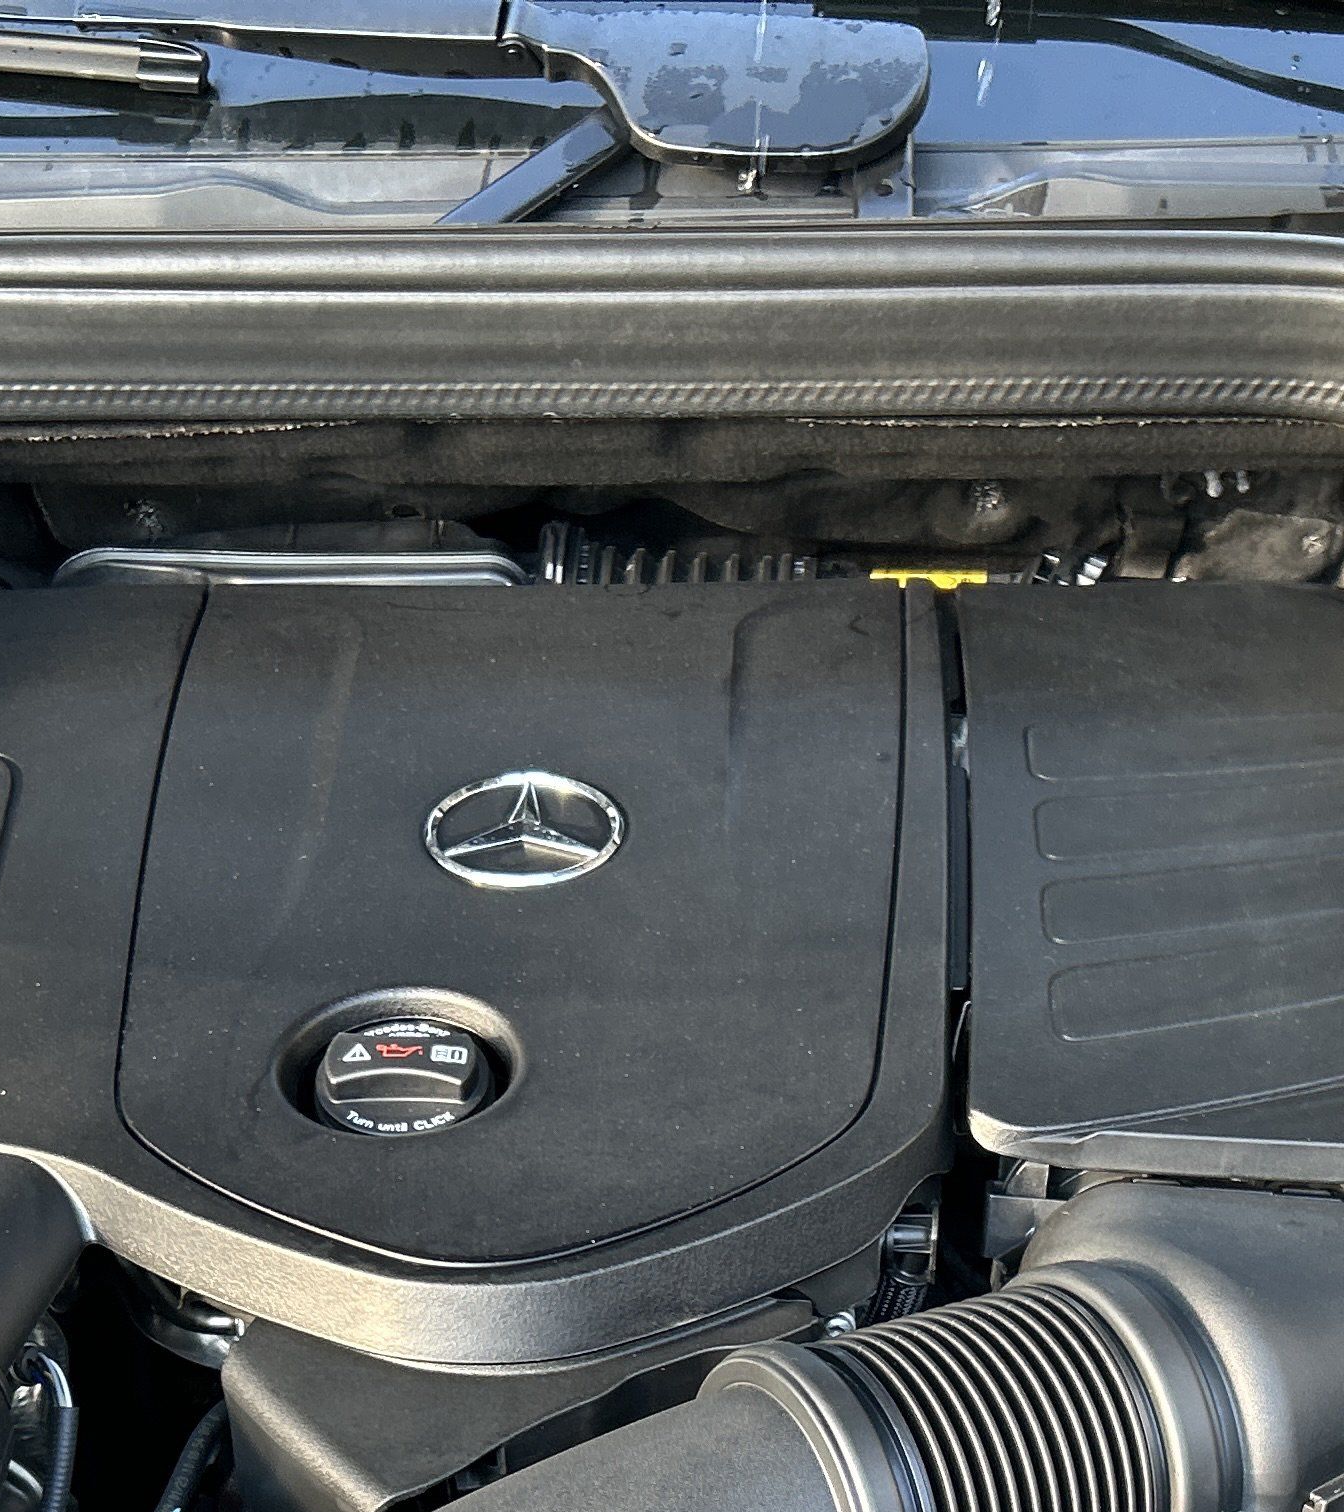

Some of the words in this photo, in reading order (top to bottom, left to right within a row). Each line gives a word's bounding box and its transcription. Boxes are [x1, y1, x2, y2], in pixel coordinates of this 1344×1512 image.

[346, 1110, 374, 1129] Turn
[377, 1122, 408, 1132] until
[413, 1111, 455, 1131] CLICK
